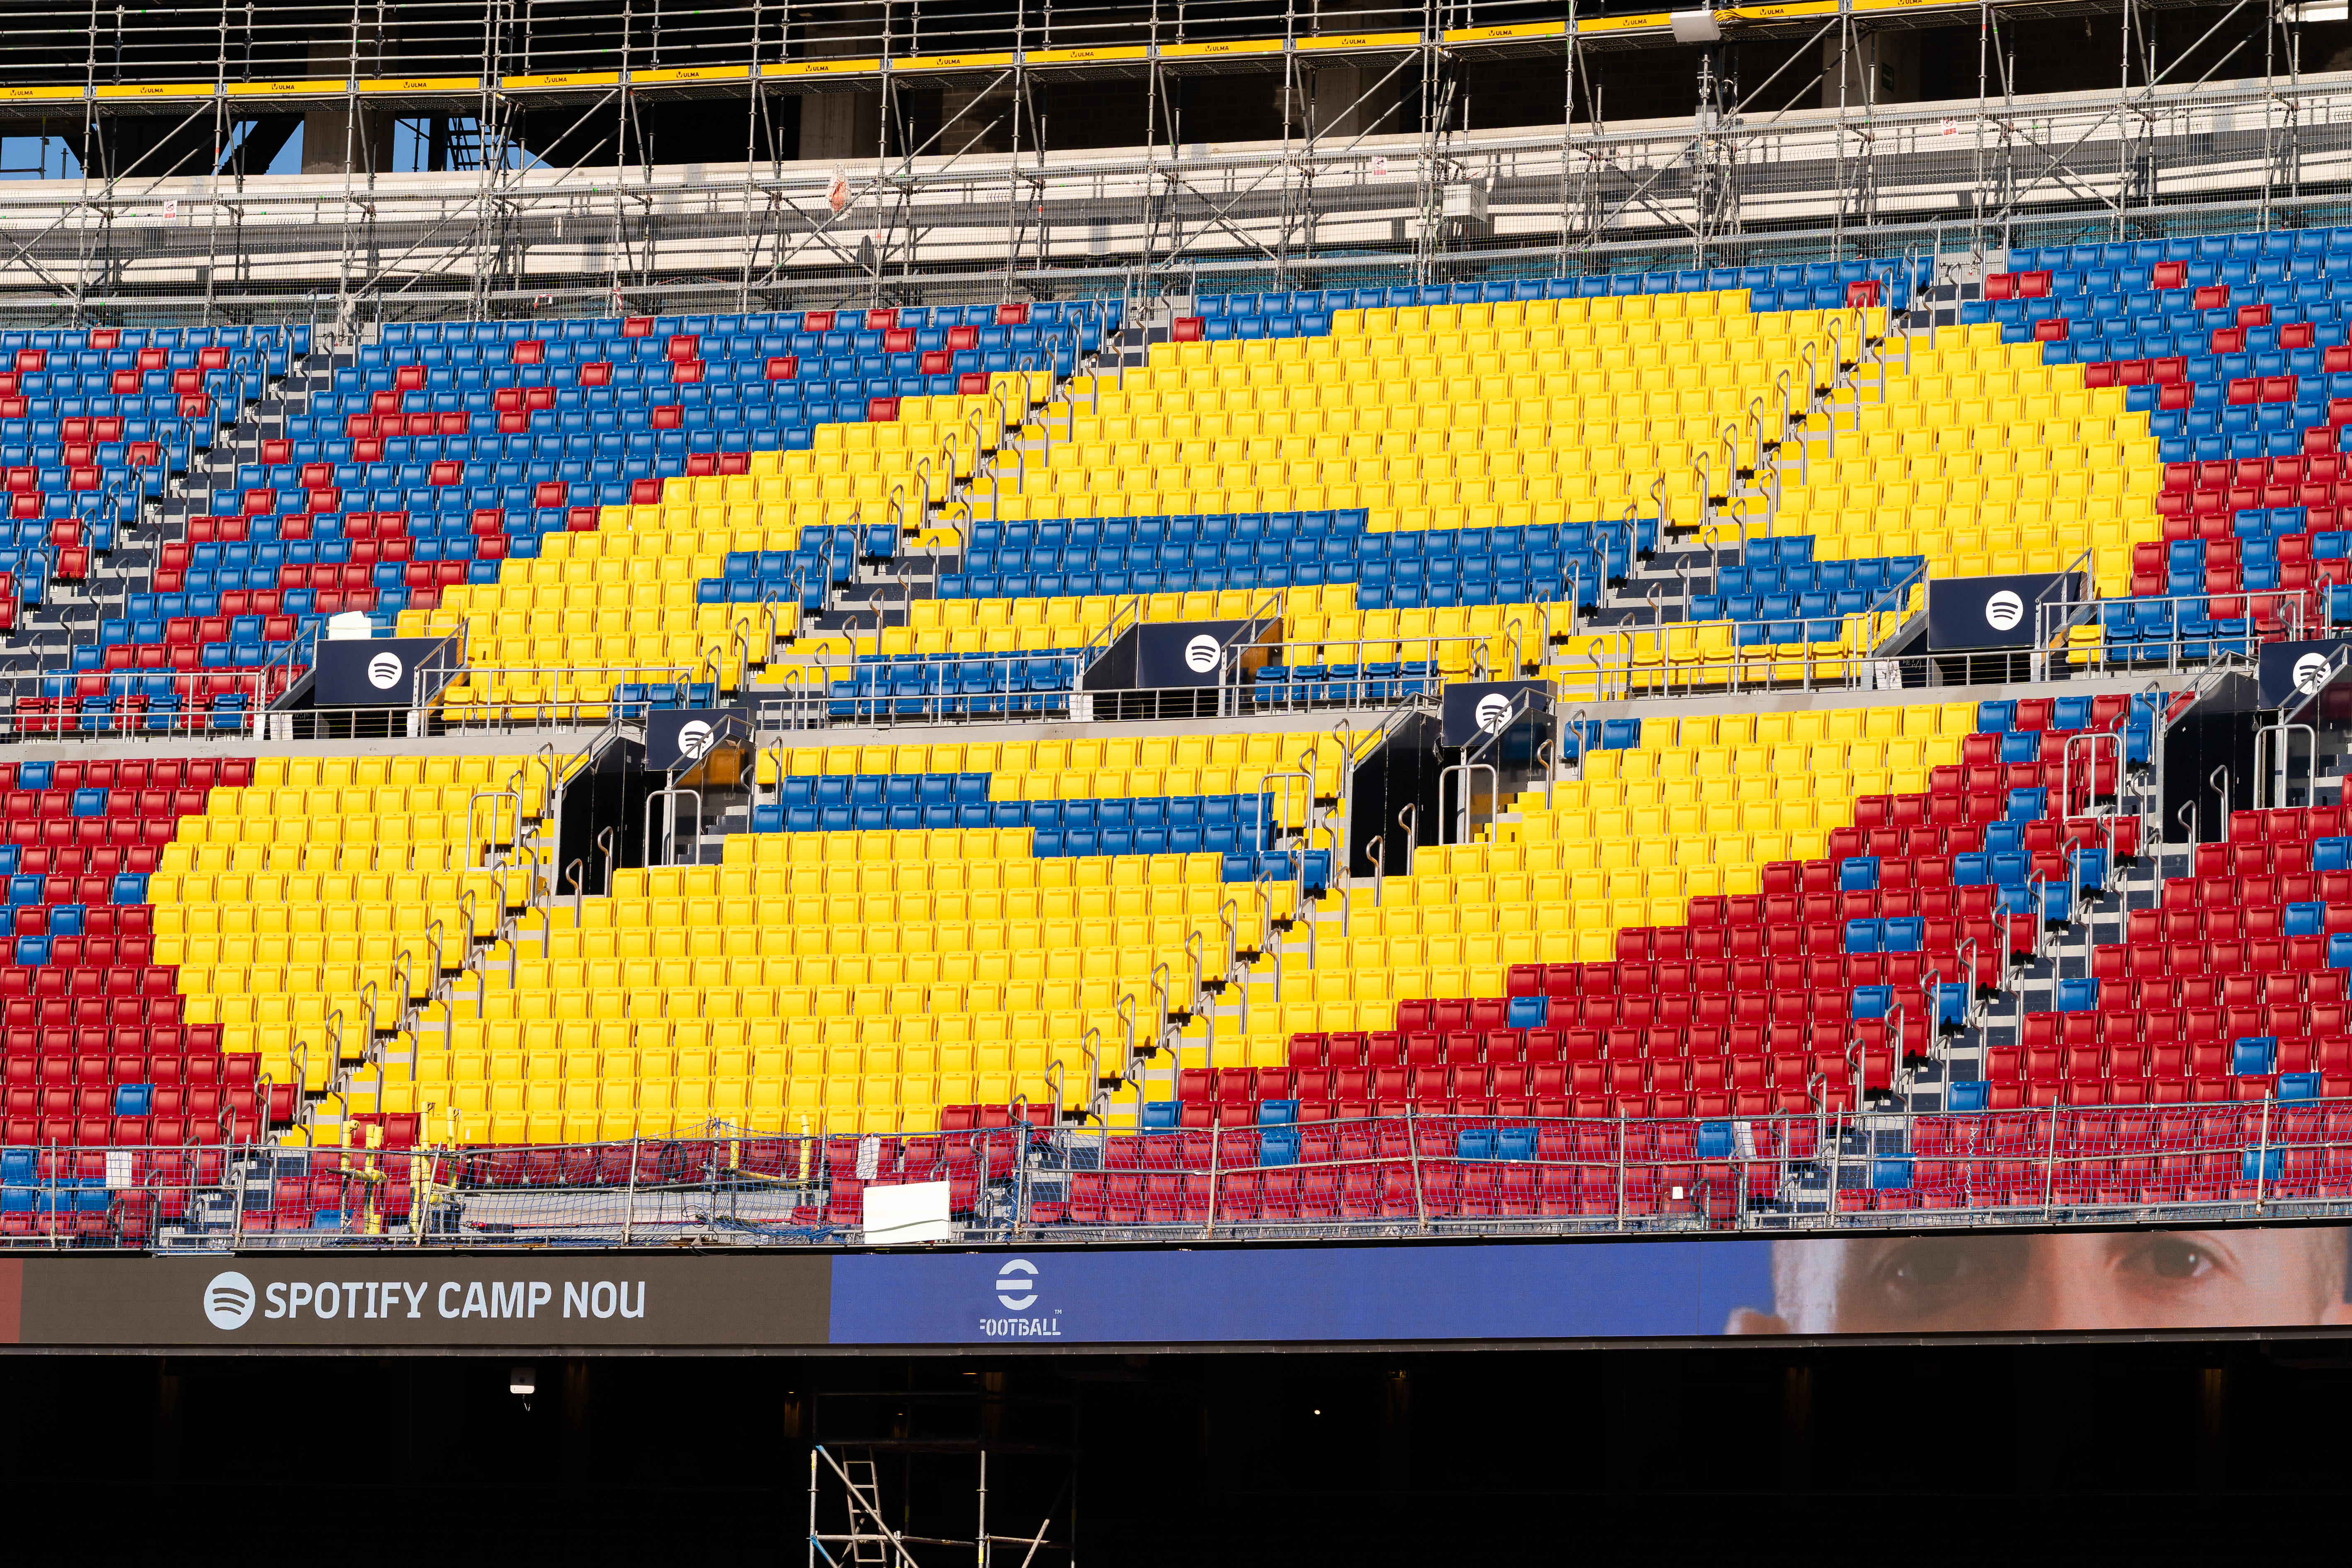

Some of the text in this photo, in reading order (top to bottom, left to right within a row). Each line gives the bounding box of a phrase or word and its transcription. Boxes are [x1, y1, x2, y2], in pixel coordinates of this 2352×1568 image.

[265, 1281, 645, 1319] SPOTIFY CAMP NOU
[980, 1318, 1061, 1336] FOOTBALL
